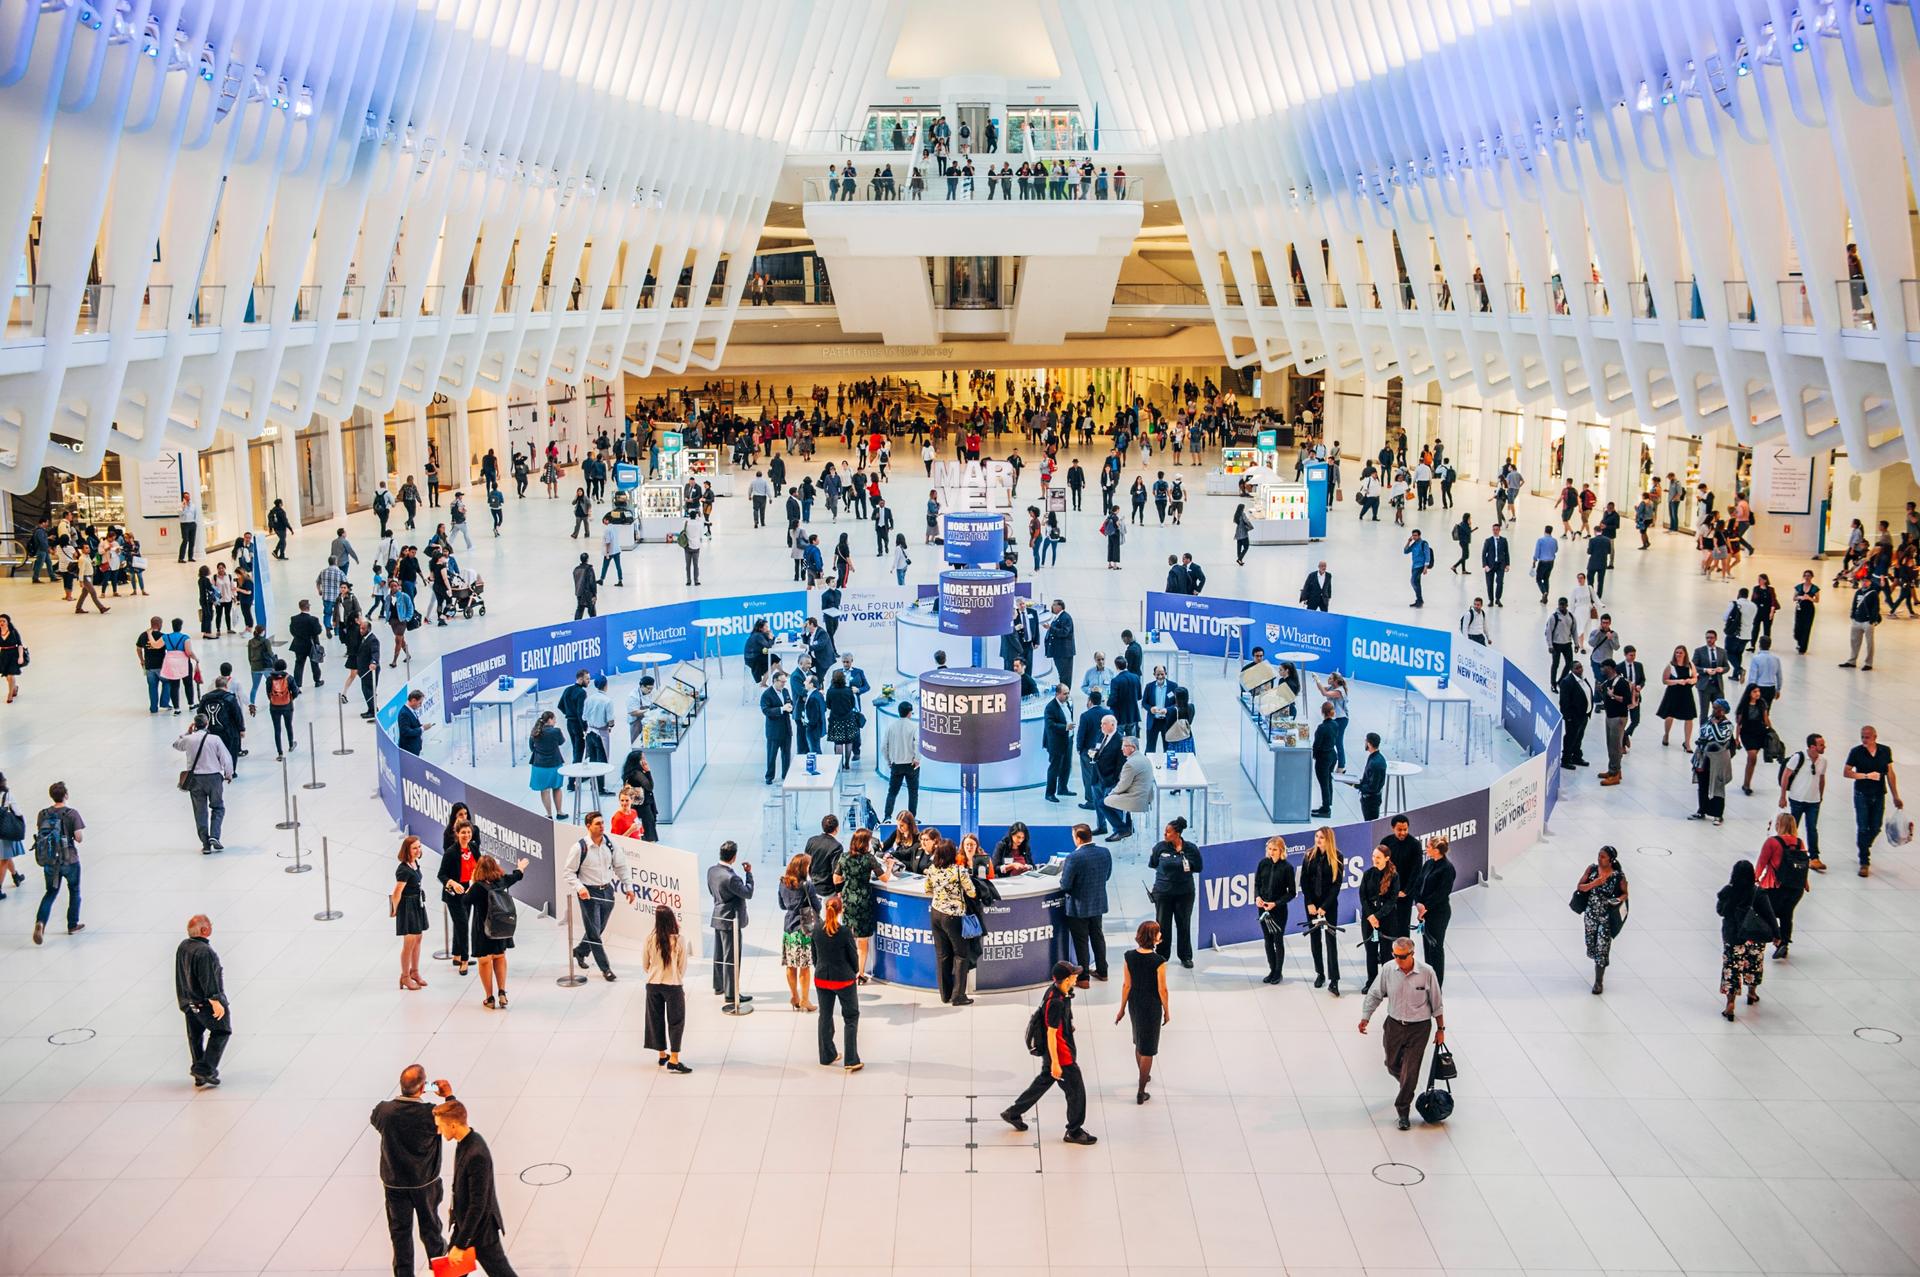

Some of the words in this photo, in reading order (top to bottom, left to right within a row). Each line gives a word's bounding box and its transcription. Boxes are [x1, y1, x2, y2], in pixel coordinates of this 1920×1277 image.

[947, 520, 970, 532] MORE
[971, 521, 994, 532] THAN
[947, 530, 989, 541] WHARTON
[943, 582, 969, 596] MORE
[971, 583, 1000, 596] THAN
[1001, 581, 1015, 595] EVE
[868, 601, 904, 611] FORUM
[943, 594, 994, 608] WHARTON
[852, 611, 898, 621] YORK20
[638, 626, 687, 643] Wharton
[1281, 625, 1331, 647] Wharton
[521, 646, 552, 672] EARLY
[552, 636, 601, 666] ADOPTERS
[1352, 637, 1446, 672] GLOBALISTS
[451, 668, 472, 684] MORE
[472, 660, 490, 675] THAN
[490, 653, 506, 670] EVER
[1457, 654, 1479, 672] GLOBAL
[1480, 663, 1497, 680] FORUM
[1457, 665, 1471, 679] NEW
[452, 673, 489, 696] WHARTON
[921, 688, 1007, 714] REGISTER
[921, 709, 962, 736] HERE
[1517, 781, 1538, 802] FORUM
[402, 778, 453, 827] VISIONAR
[1450, 819, 1477, 843] EVER
[1494, 816, 1507, 836] NEW
[474, 814, 498, 840] MORE
[497, 825, 520, 850] THAN
[521, 832, 543, 860] EVER
[480, 832, 518, 865] HARTON
[631, 867, 680, 891] FORUM
[634, 901, 656, 916] JUNE
[876, 921, 936, 944] REGISTE
[983, 925, 1054, 945] REGISTER
[876, 937, 910, 957] HERE
[983, 944, 1023, 961] HERE
